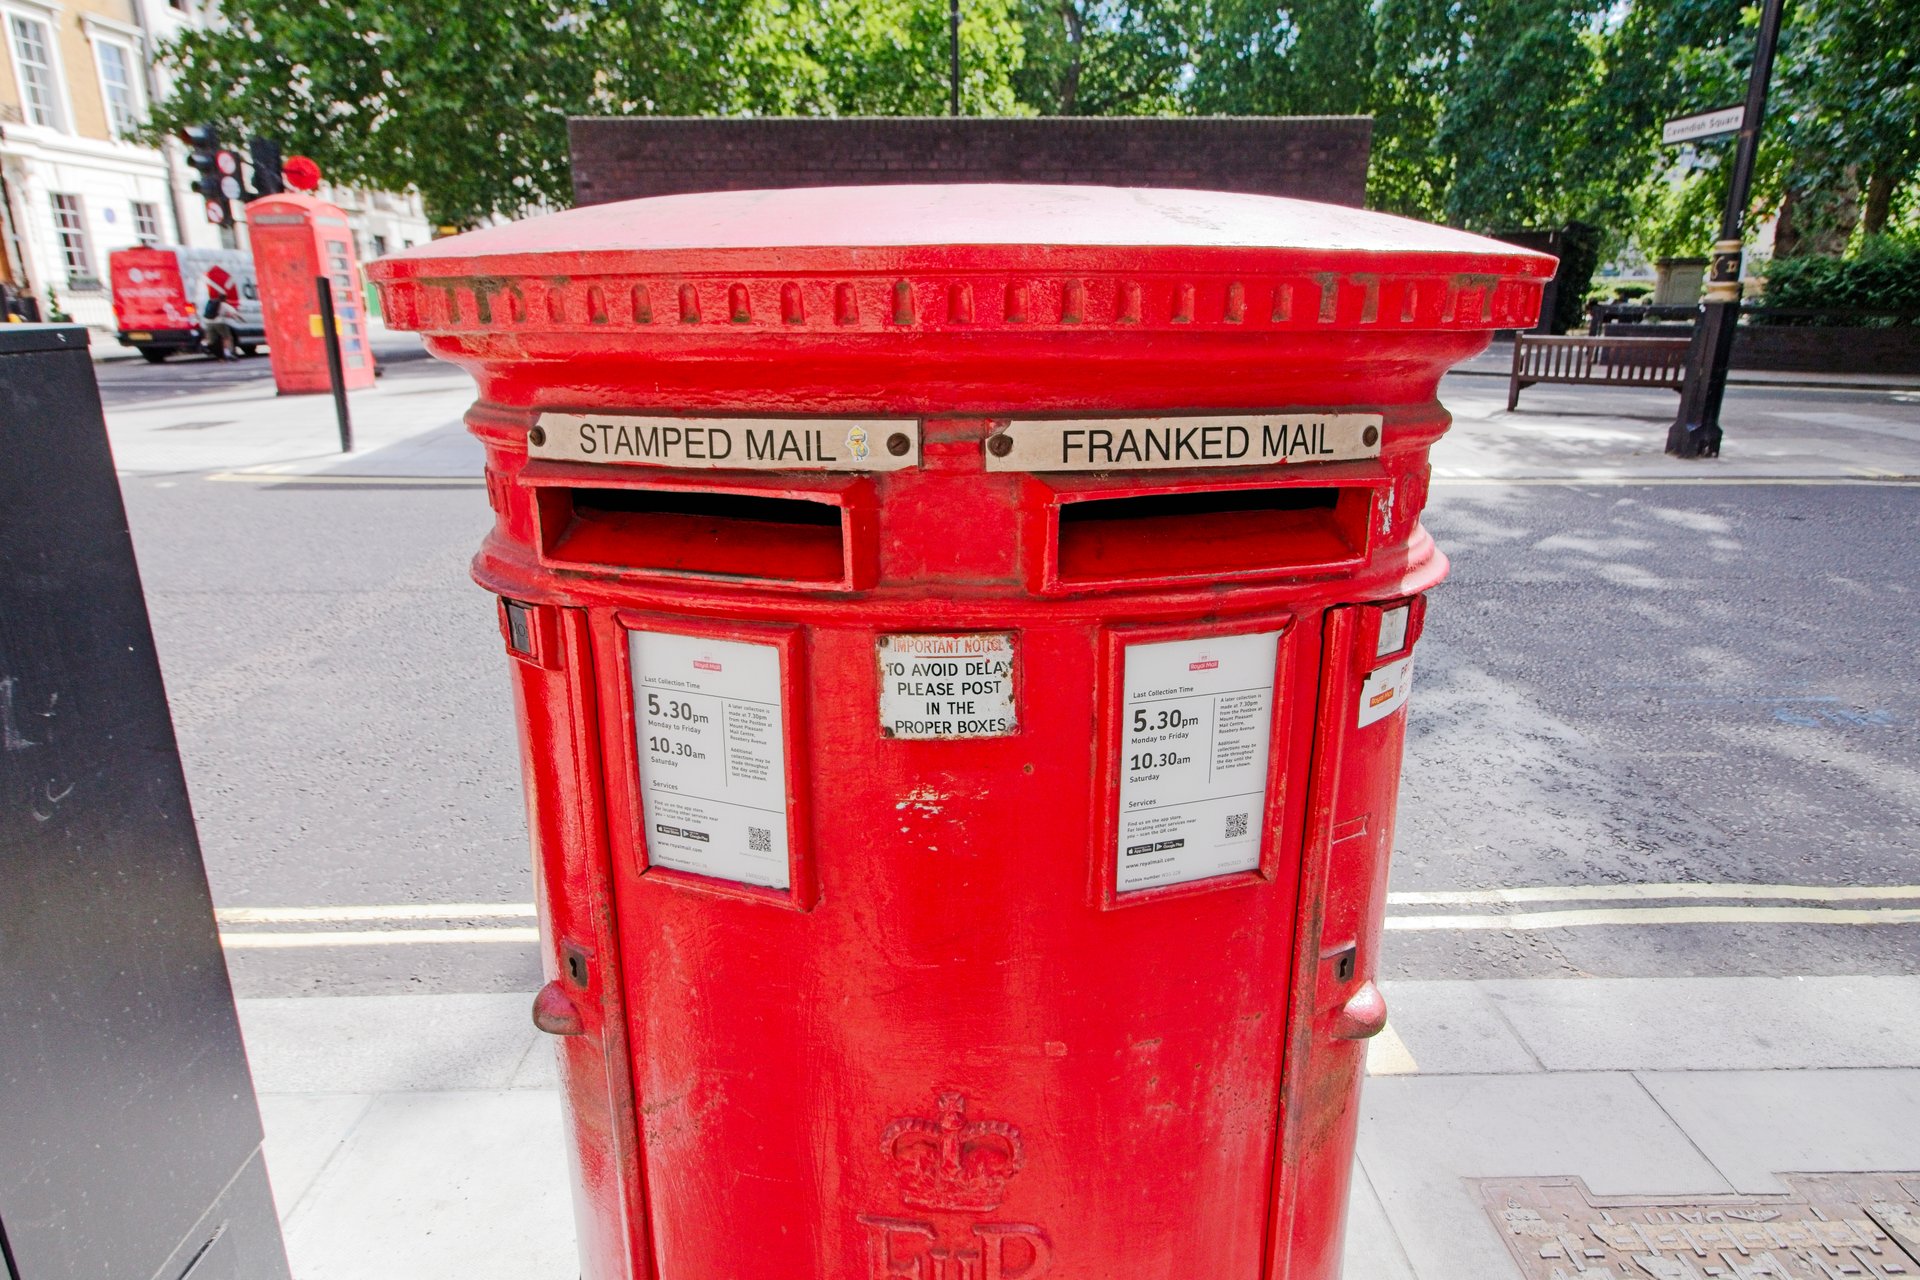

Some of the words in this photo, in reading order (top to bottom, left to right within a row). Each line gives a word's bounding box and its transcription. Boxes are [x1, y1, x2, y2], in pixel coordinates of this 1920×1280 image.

[1666, 122, 1706, 136] Cavendish
[1709, 115, 1740, 128] Square
[580, 424, 732, 459] STAMPED
[746, 430, 836, 462] MAIL
[1062, 426, 1249, 463] FRANKED
[1263, 424, 1334, 457] MAIL
[894, 640, 960, 654] IMPORTANT
[887, 663, 904, 676] TO
[912, 663, 958, 676] AVOID
[658, 678, 684, 687] Collection
[898, 683, 954, 696] PLEASE
[962, 681, 1001, 695] POST
[1148, 688, 1178, 697] Collection
[648, 694, 709, 724] 5.30pm
[926, 702, 940, 714] IN
[947, 702, 975, 714] THE
[648, 720, 672, 730] Monday
[682, 724, 701, 734] Friday
[896, 720, 952, 734] PROPER
[958, 718, 1006, 734] BOXES
[1134, 709, 1198, 732] 5.30pm
[1131, 734, 1157, 744] Monday
[1168, 732, 1189, 740] Friday
[650, 736, 706, 760] 10.30am
[650, 756, 678, 768] Saturday
[1130, 752, 1190, 770] 10.30am
[652, 780, 678, 790] Services
[1130, 774, 1160, 784] Saturday
[1128, 798, 1156, 808] Services
[1126, 857, 1175, 869] www.royalmail.com
